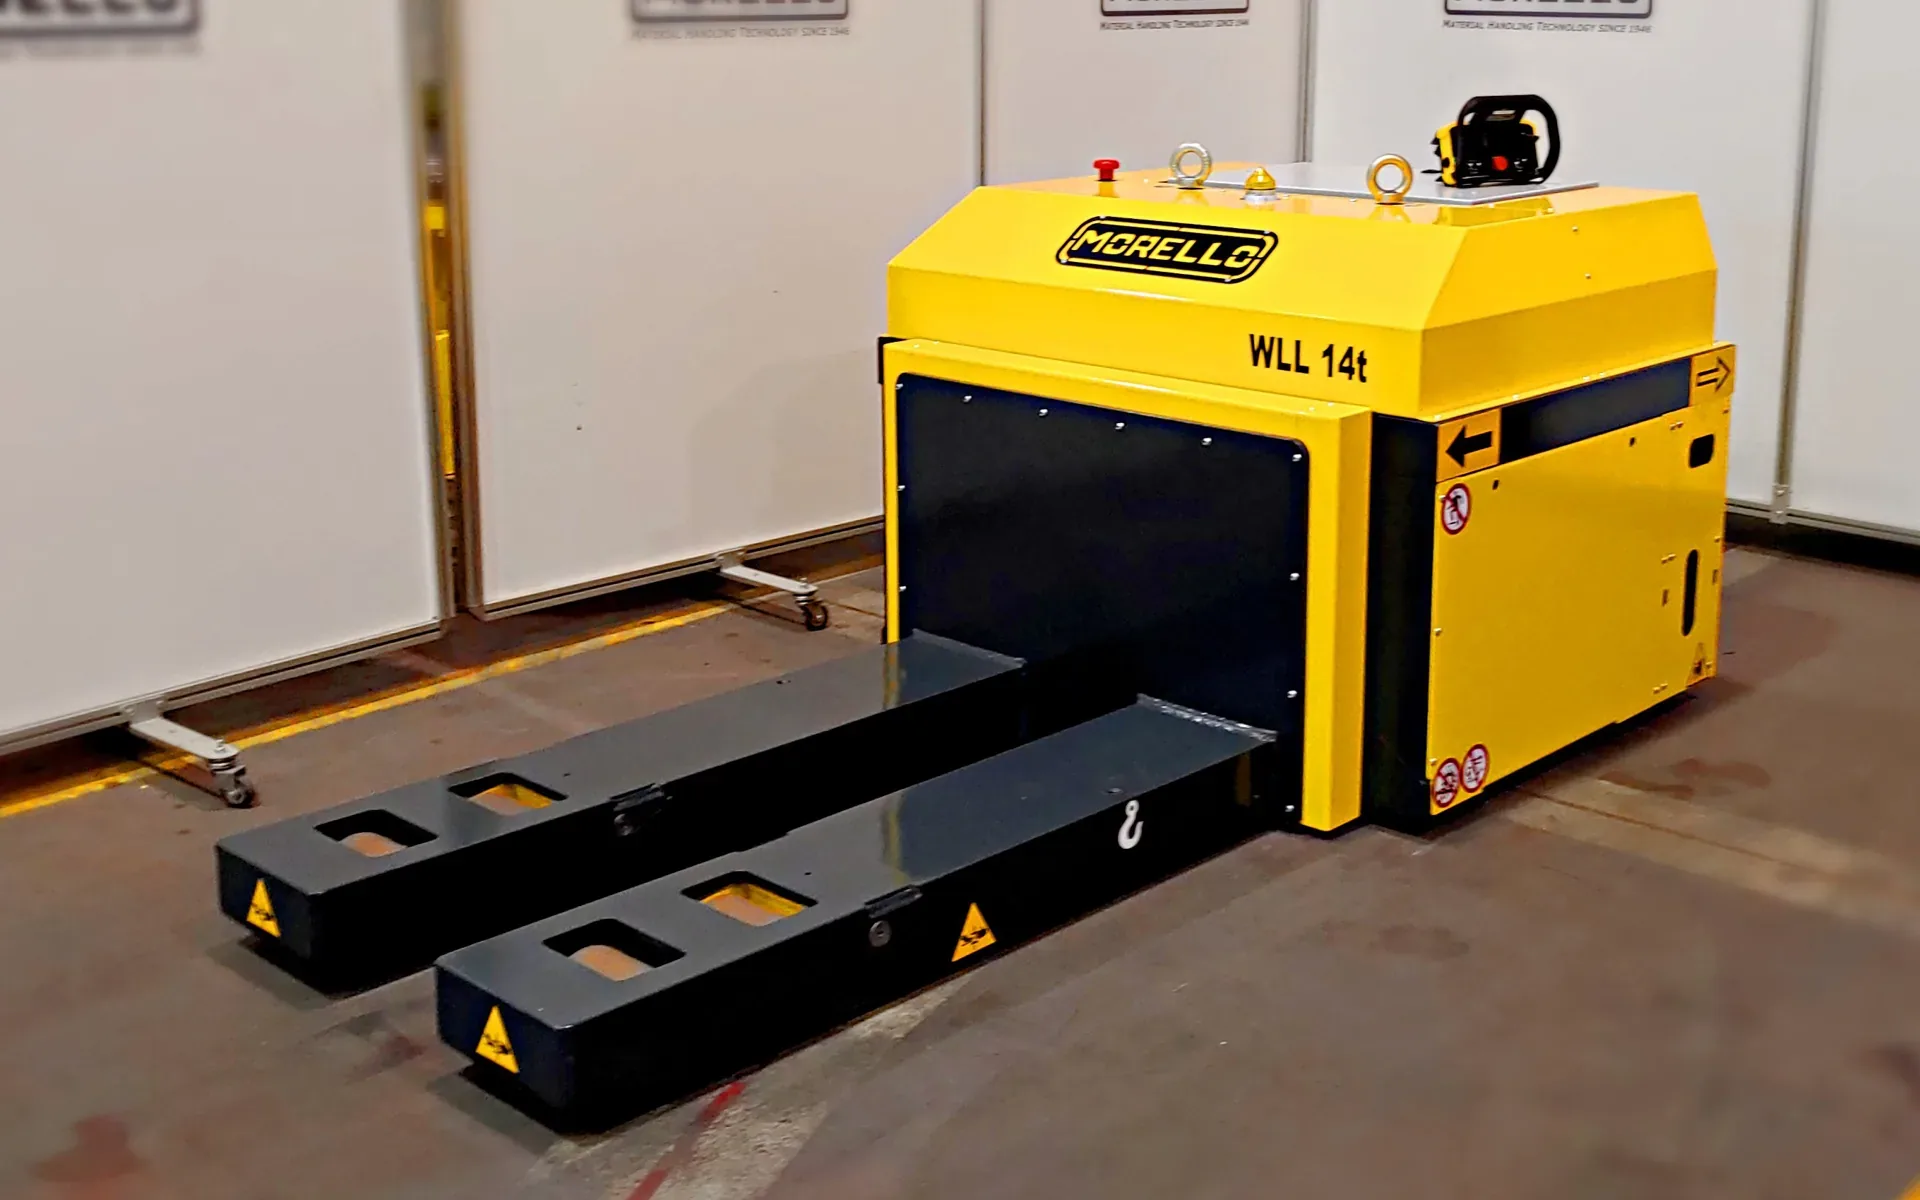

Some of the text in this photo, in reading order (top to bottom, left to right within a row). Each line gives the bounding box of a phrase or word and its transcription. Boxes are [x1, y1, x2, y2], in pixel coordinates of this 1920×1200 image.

[1537, 22, 1596, 32] TECHNOLOGY
[1071, 229, 1260, 269] MORELLO
[1249, 333, 1368, 383] WLL 14t
